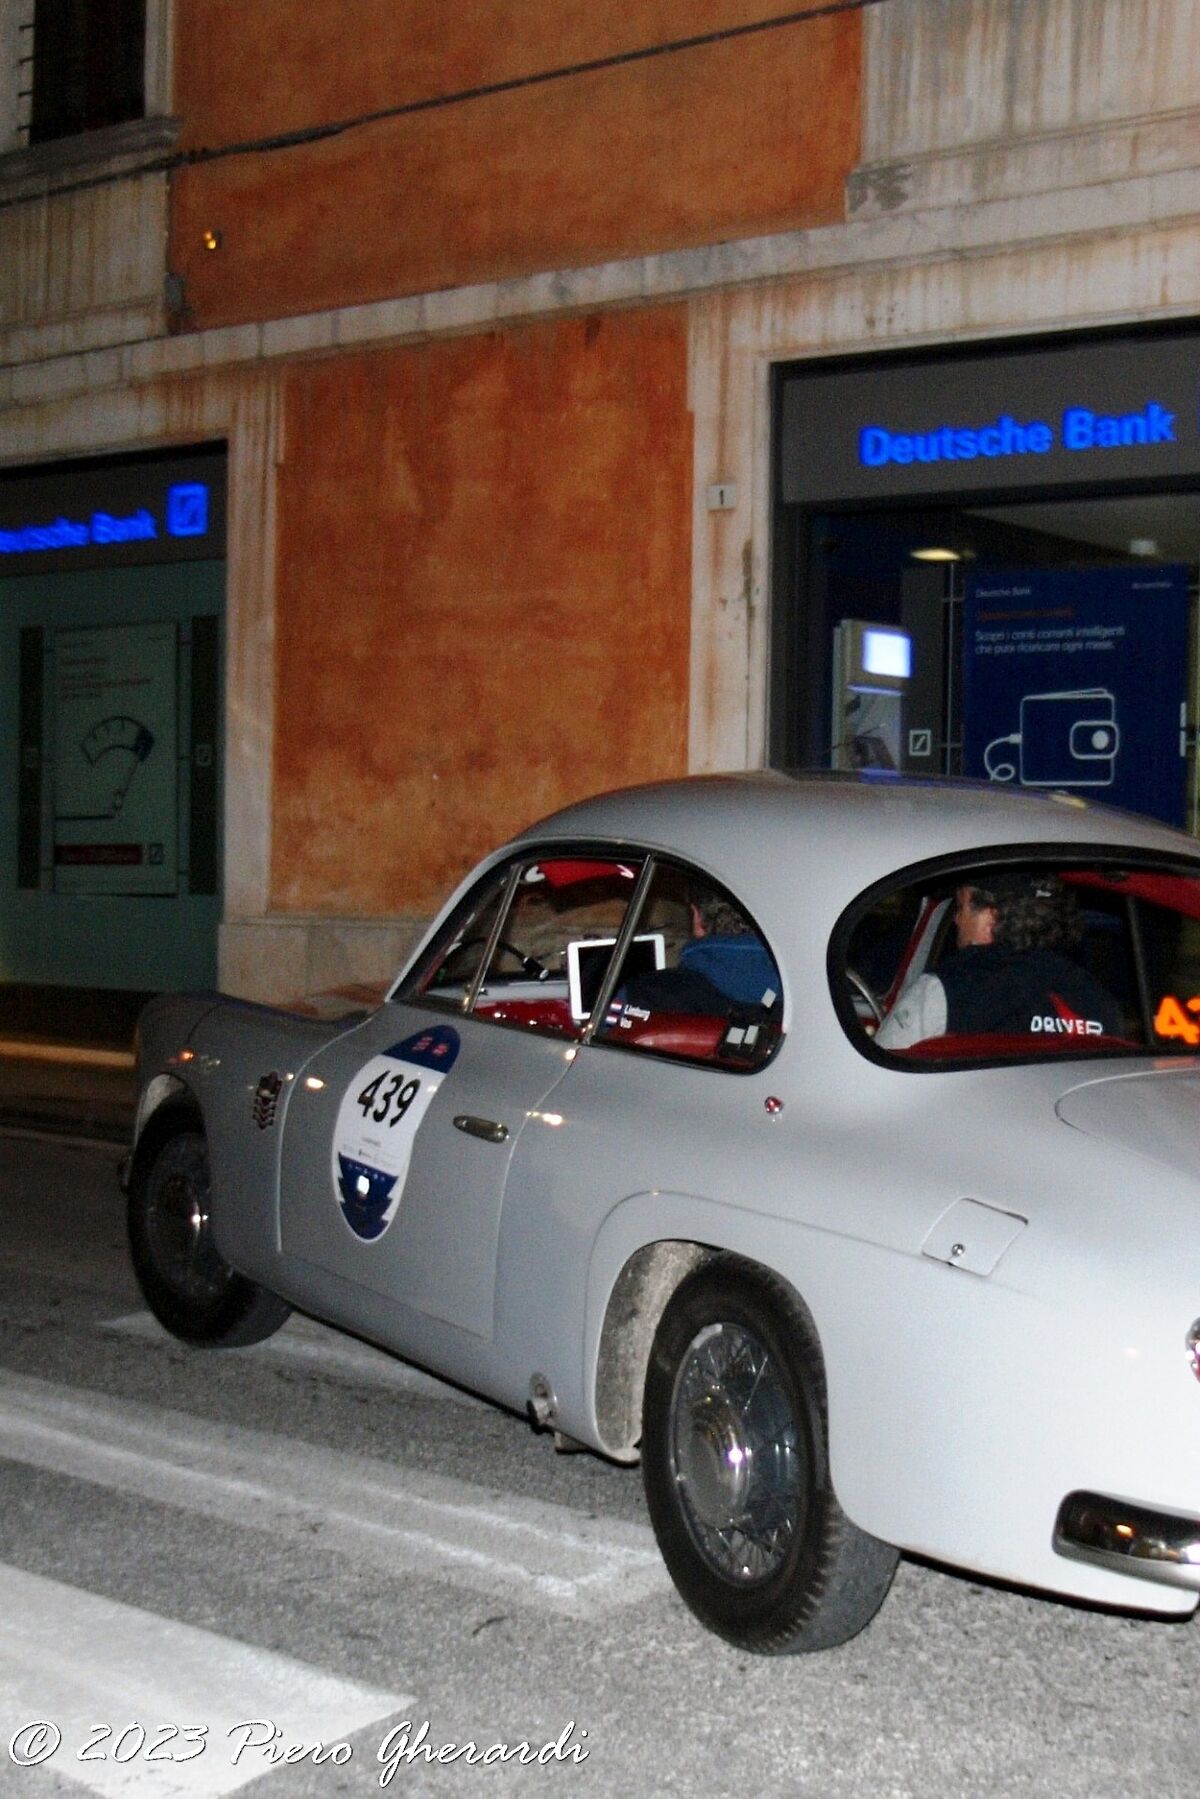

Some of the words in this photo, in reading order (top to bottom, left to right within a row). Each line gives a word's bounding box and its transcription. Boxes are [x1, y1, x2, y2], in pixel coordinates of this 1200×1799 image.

[859, 414, 1053, 467] Deutsche
[1062, 400, 1177, 451] Bank
[357, 1070, 421, 1128] 439
